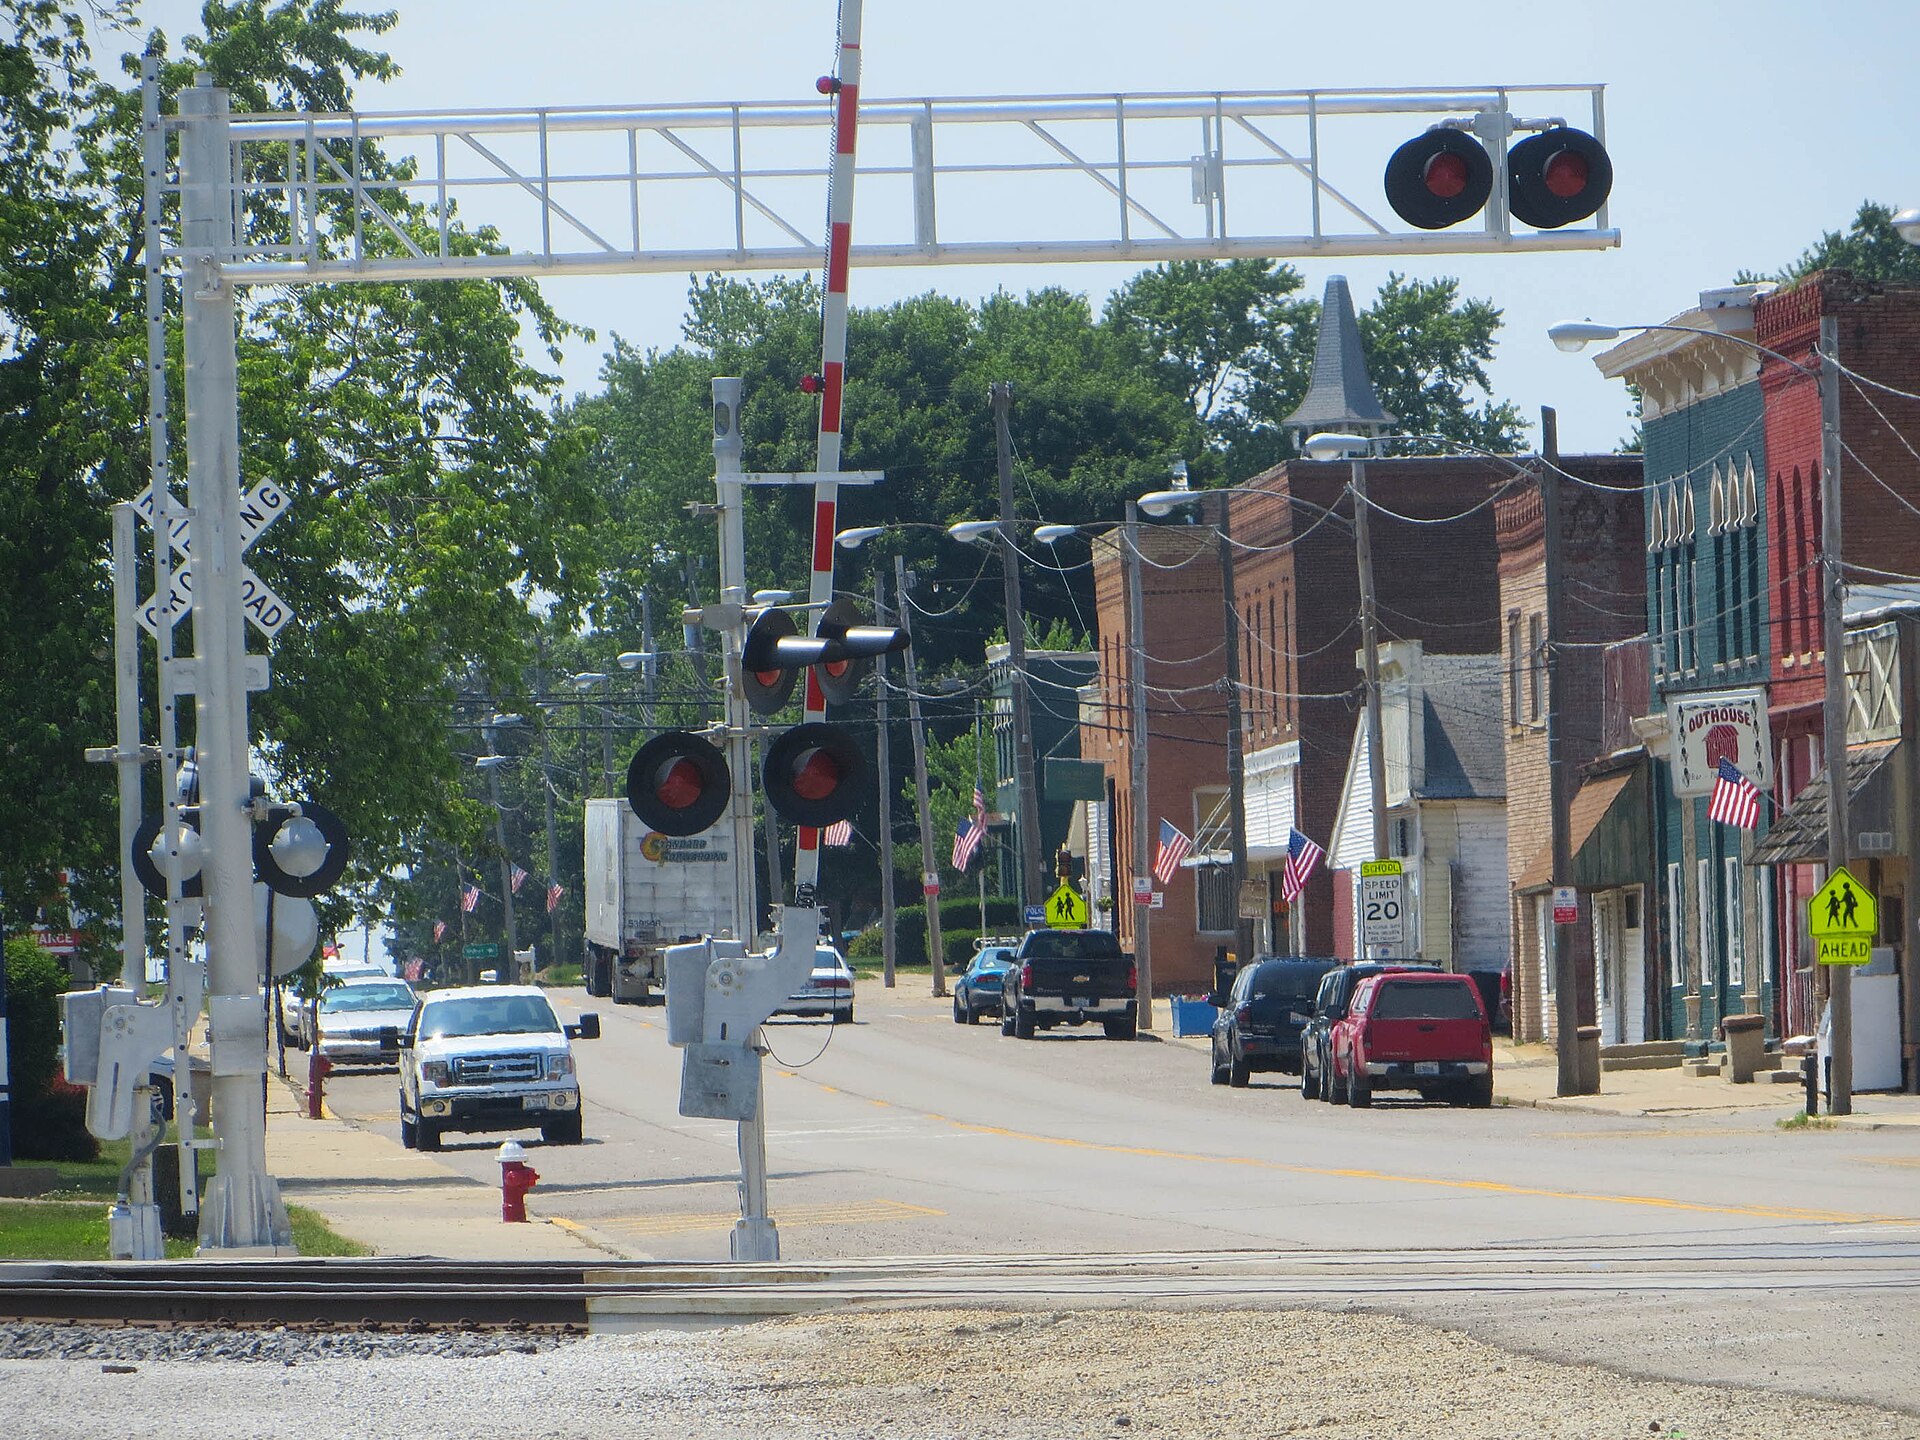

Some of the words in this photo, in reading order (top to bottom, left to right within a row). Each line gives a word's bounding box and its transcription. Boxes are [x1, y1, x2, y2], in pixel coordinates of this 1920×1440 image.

[1688, 707, 1752, 733] OUTHOUSE
[1363, 864, 1399, 874] SCHOOL
[1364, 880, 1399, 890] SPEED
[1368, 890, 1395, 900] LIMIT
[1025, 907, 1045, 915] POLIC
[1366, 901, 1400, 921] 20
[1820, 942, 1868, 958] AHEAD
